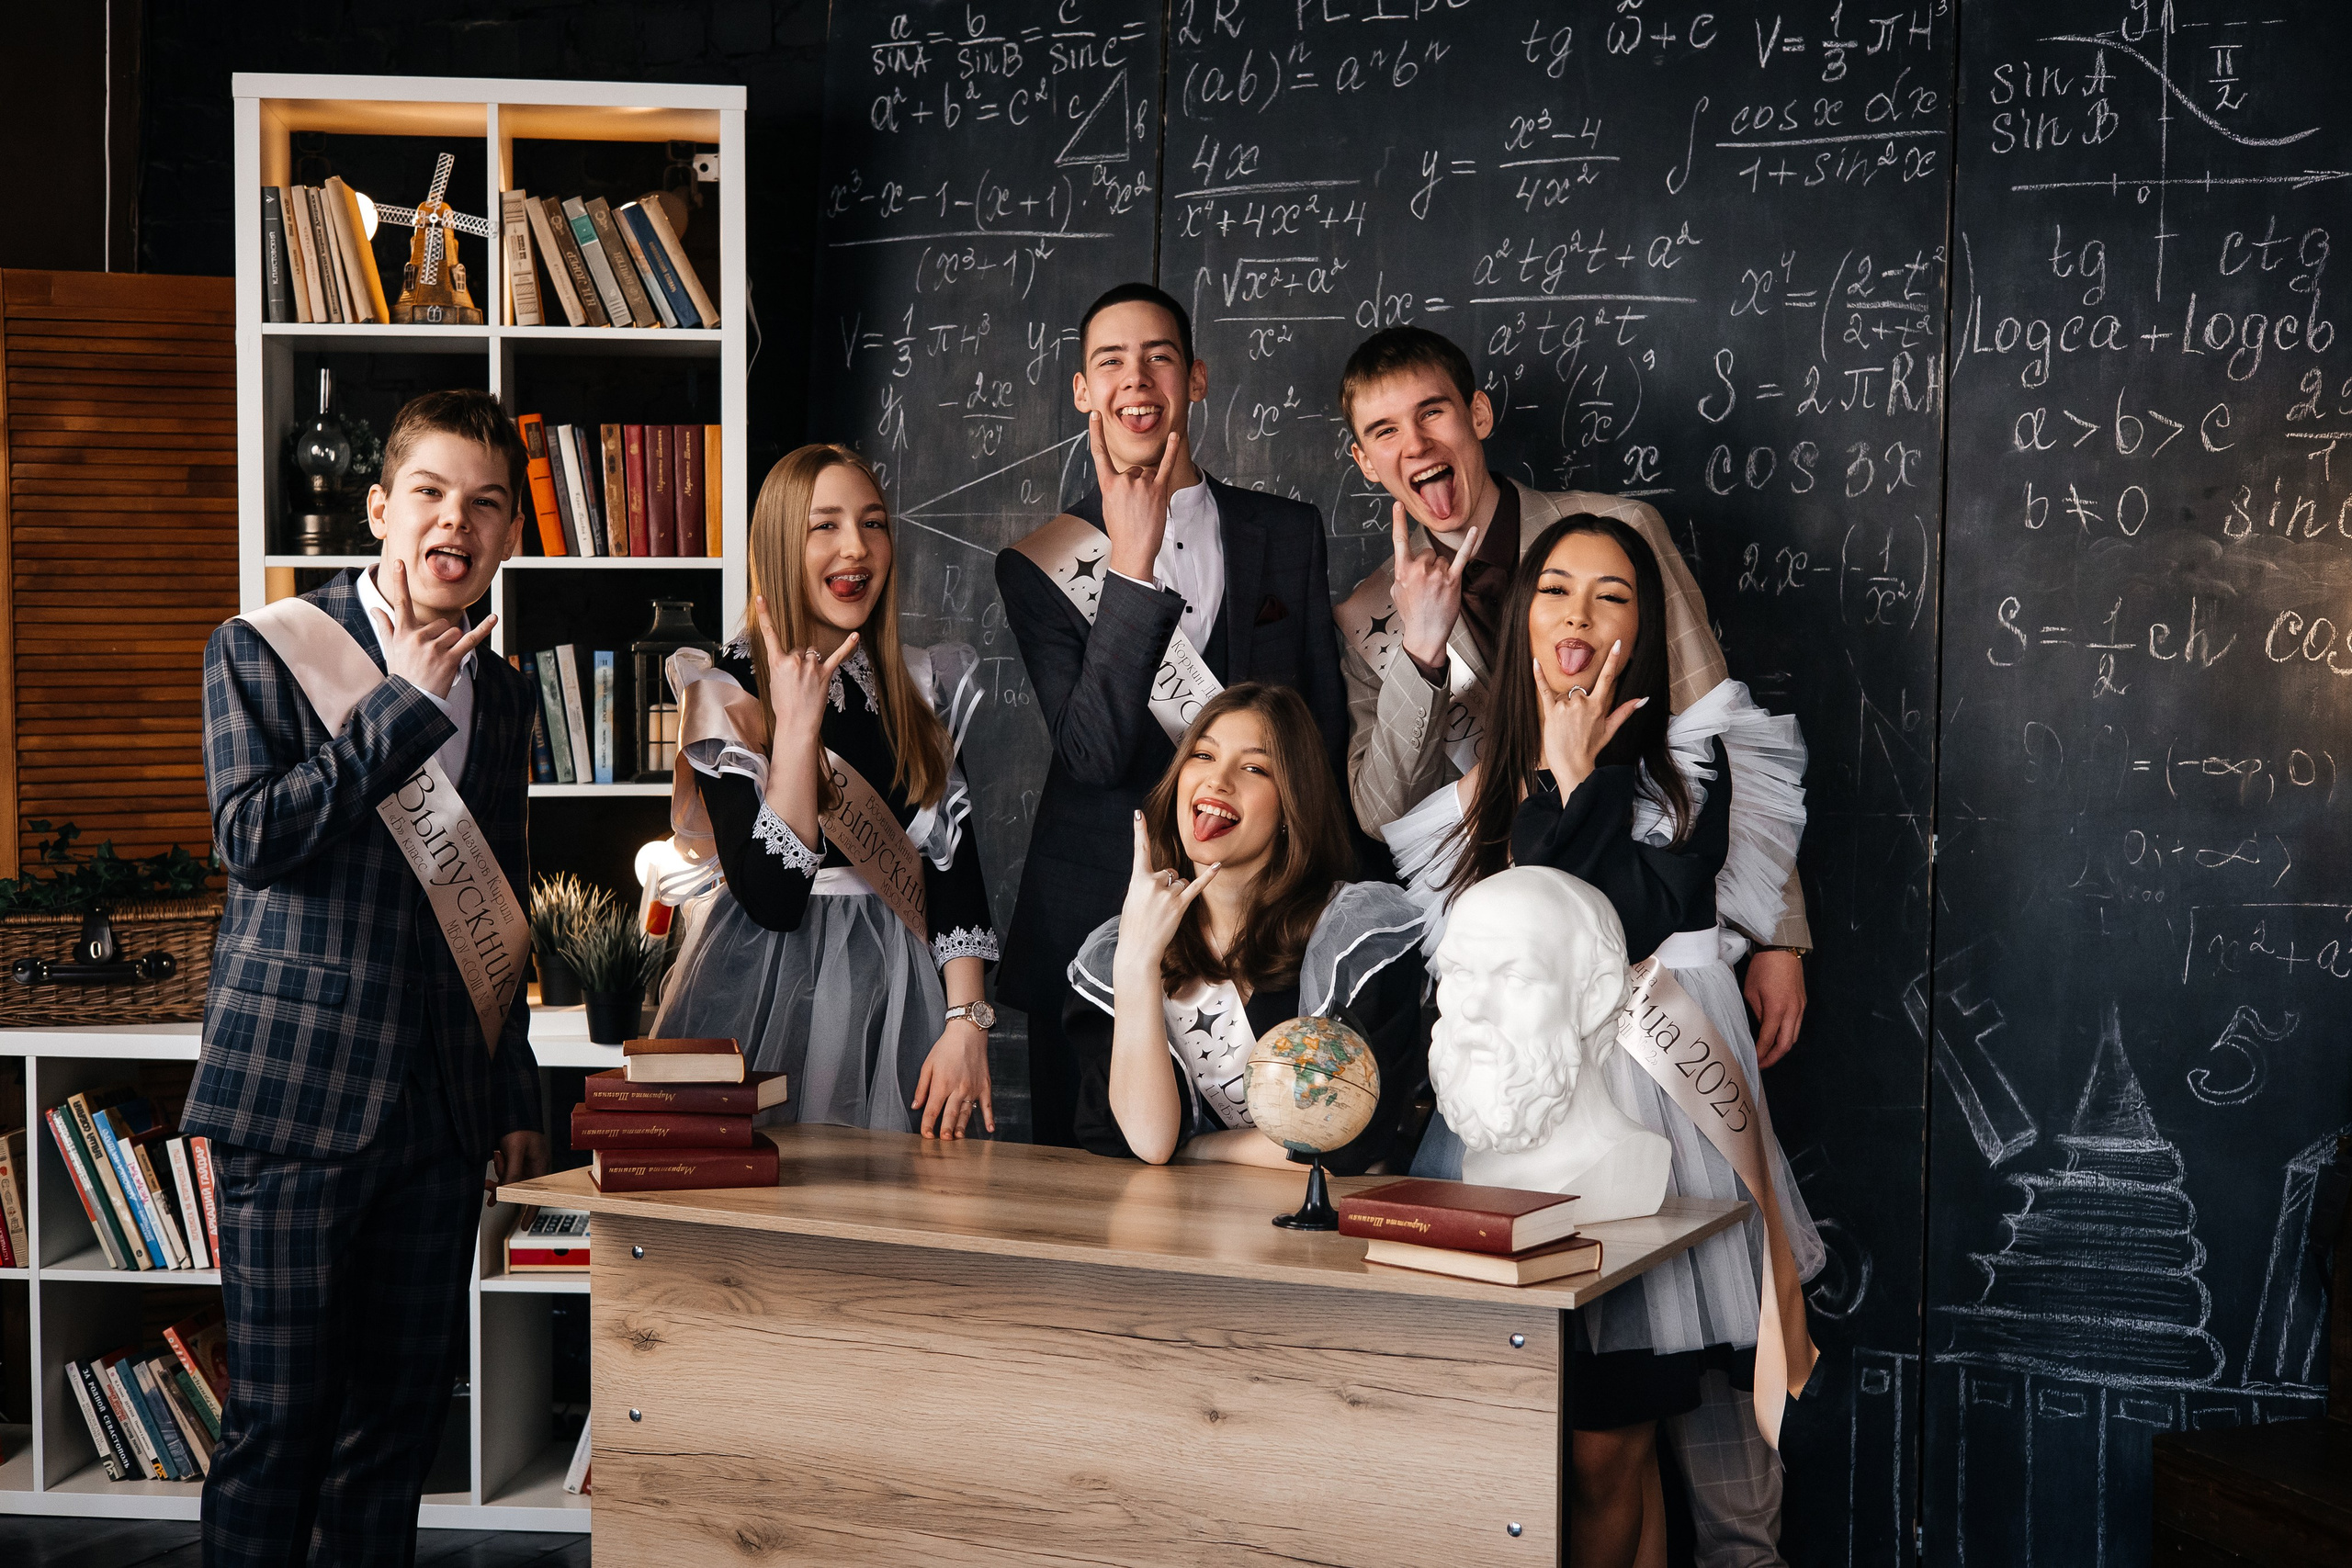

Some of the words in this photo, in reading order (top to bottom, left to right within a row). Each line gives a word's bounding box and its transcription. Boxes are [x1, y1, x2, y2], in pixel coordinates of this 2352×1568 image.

[1171, 639, 1204, 685] Коркин
[837, 832, 862, 860] класс
[865, 795, 896, 841] Вдовина
[896, 836, 914, 864] Анна
[402, 837, 428, 873] класс
[456, 818, 491, 876] Сизиков
[487, 876, 514, 926] Кирилл
[394, 765, 515, 1000] Выпускник
[880, 881, 904, 908] МБОУ
[445, 919, 469, 954] МБОУ
[1675, 1036, 1752, 1134] 2025
[71, 1100, 92, 1133] СОБАКА
[85, 1132, 103, 1159] ВАША
[195, 1145, 209, 1185] ГАЙДАР
[201, 1187, 218, 1235] АРКАДИЙ
[82, 1368, 91, 1379] ЗА
[87, 1380, 106, 1413] РОДНОЙ
[102, 1415, 130, 1470] СЕВАСТОПОЛЬ
